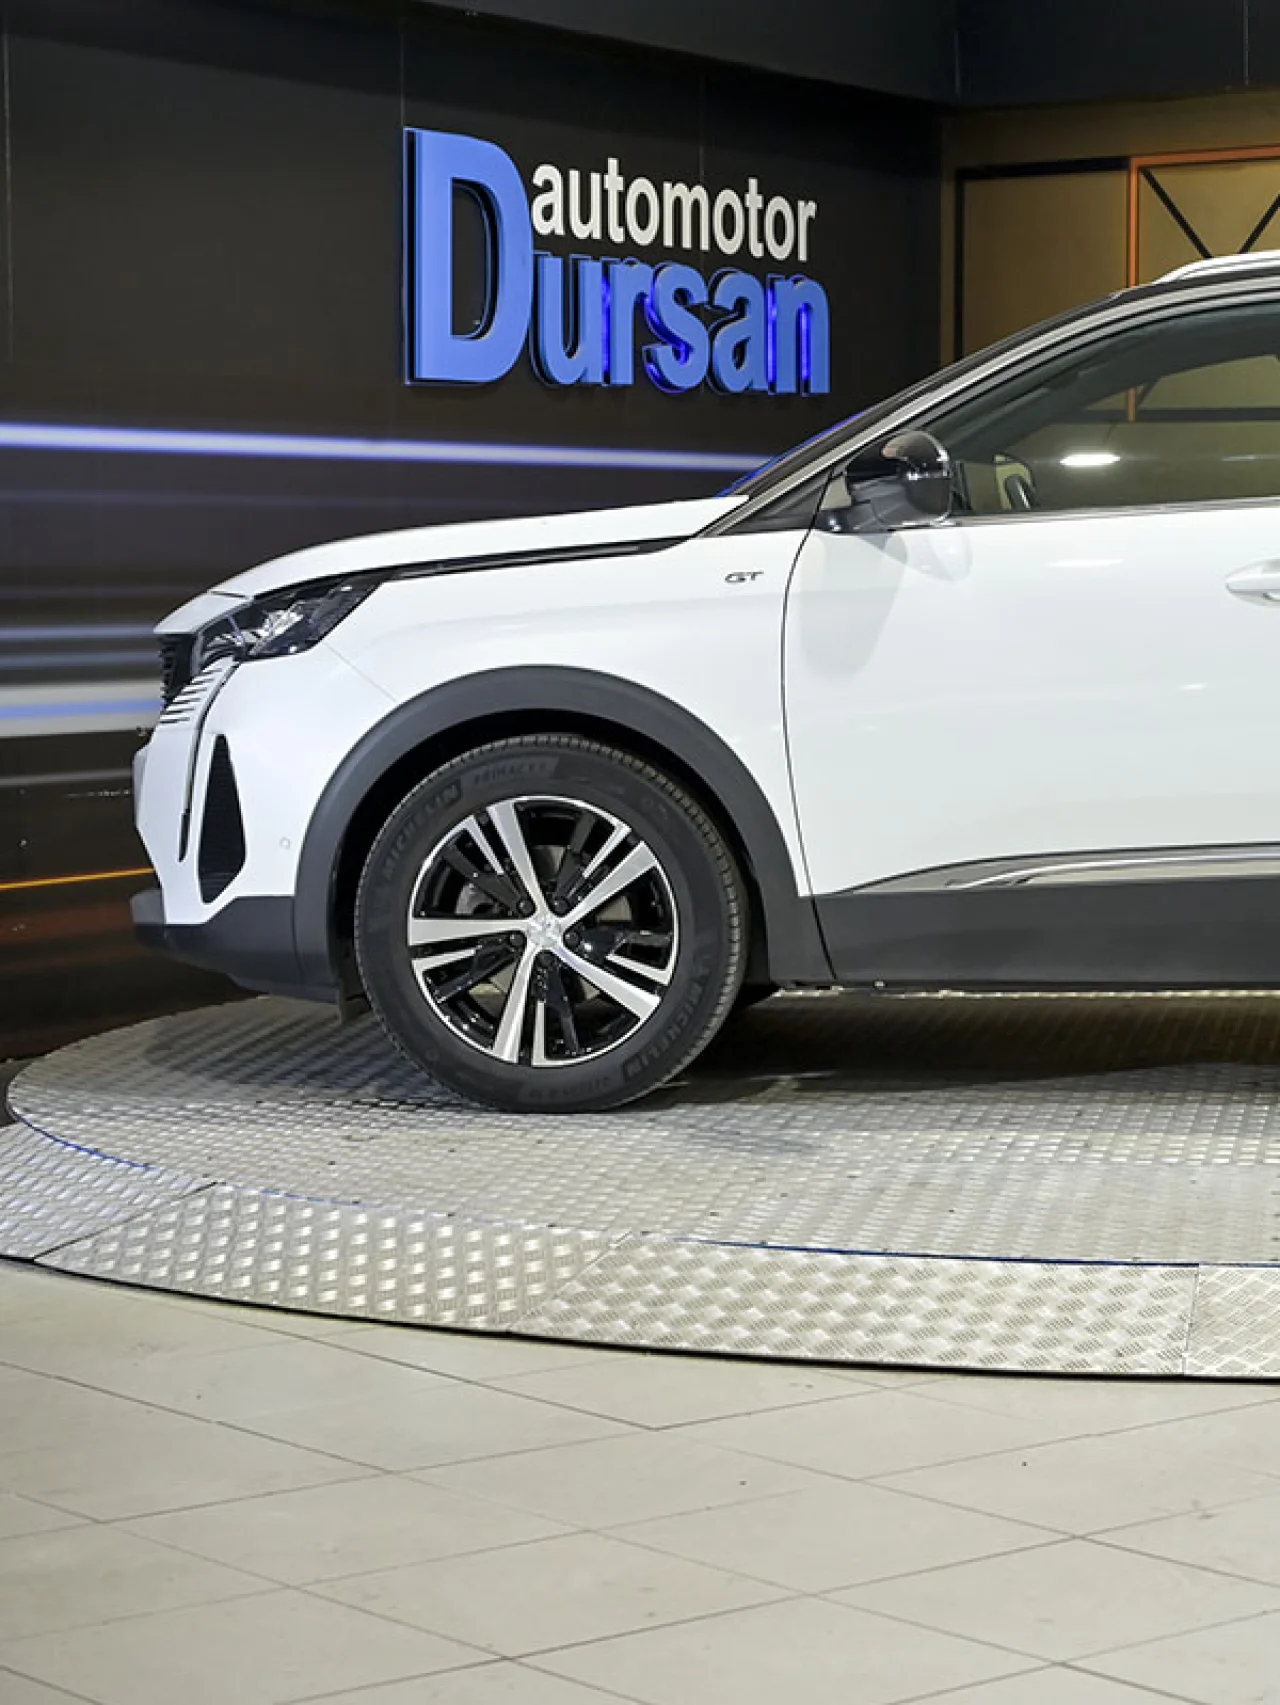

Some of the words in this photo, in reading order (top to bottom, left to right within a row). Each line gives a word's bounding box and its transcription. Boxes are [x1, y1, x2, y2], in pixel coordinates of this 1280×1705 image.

[403, 126, 830, 396] Dursan
[531, 157, 817, 262] automotor
[724, 570, 764, 583] GT
